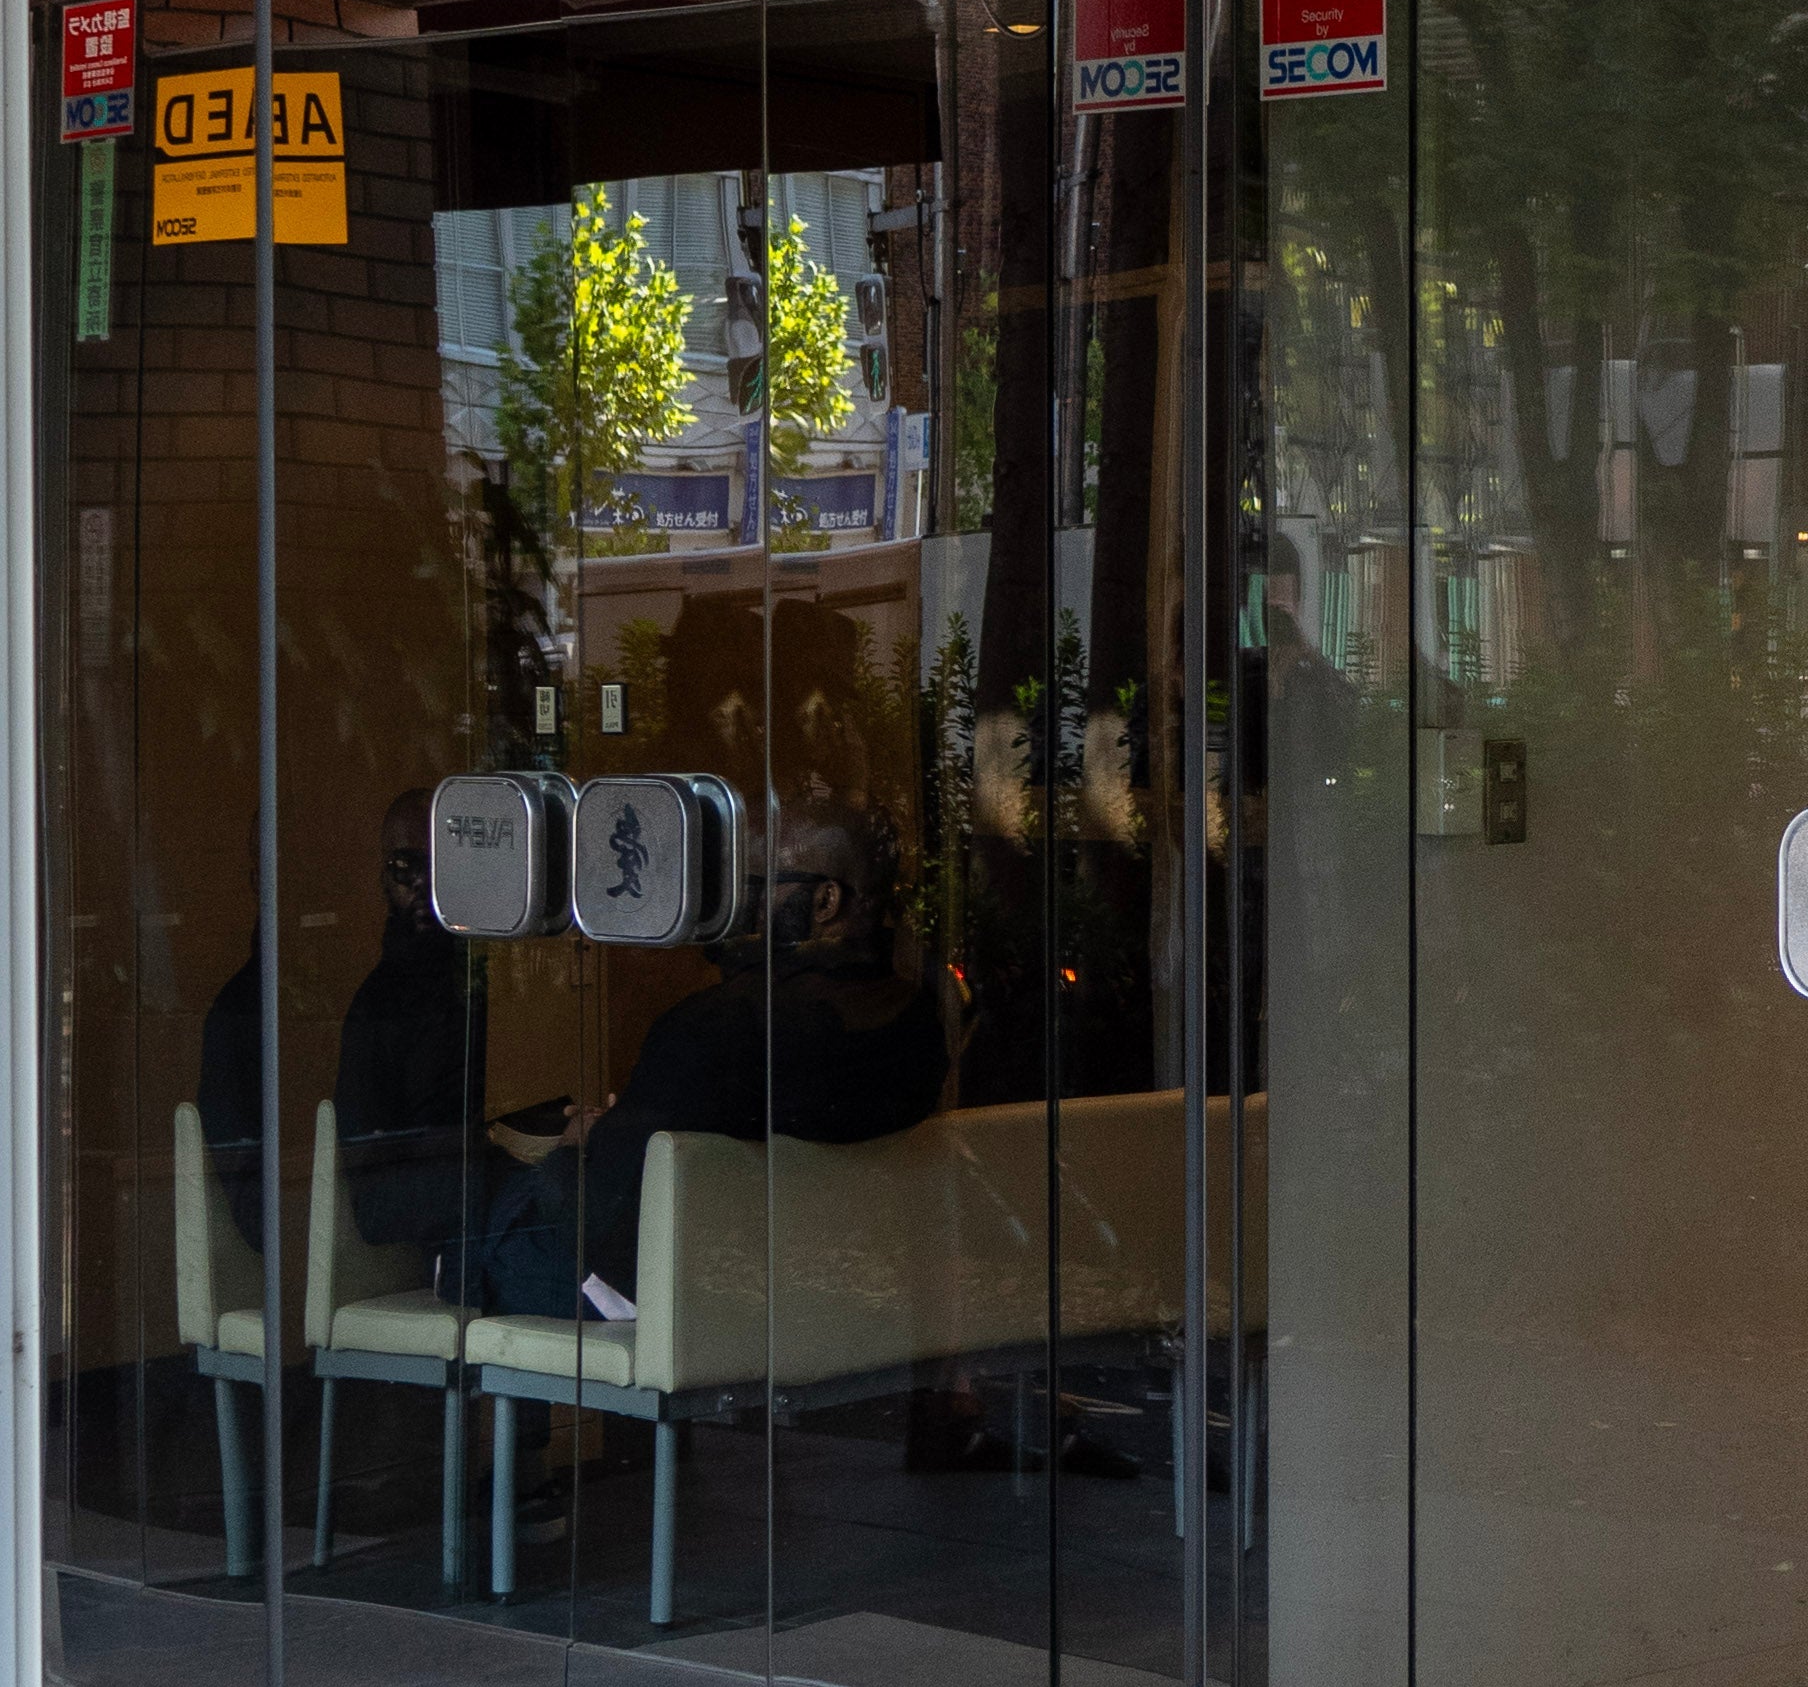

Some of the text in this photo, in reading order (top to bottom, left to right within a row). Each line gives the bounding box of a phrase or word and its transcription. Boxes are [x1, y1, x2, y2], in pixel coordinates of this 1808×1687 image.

[1300, 6, 1345, 26] Security
[1315, 23, 1329, 39] by
[1268, 40, 1378, 85] SECOM
